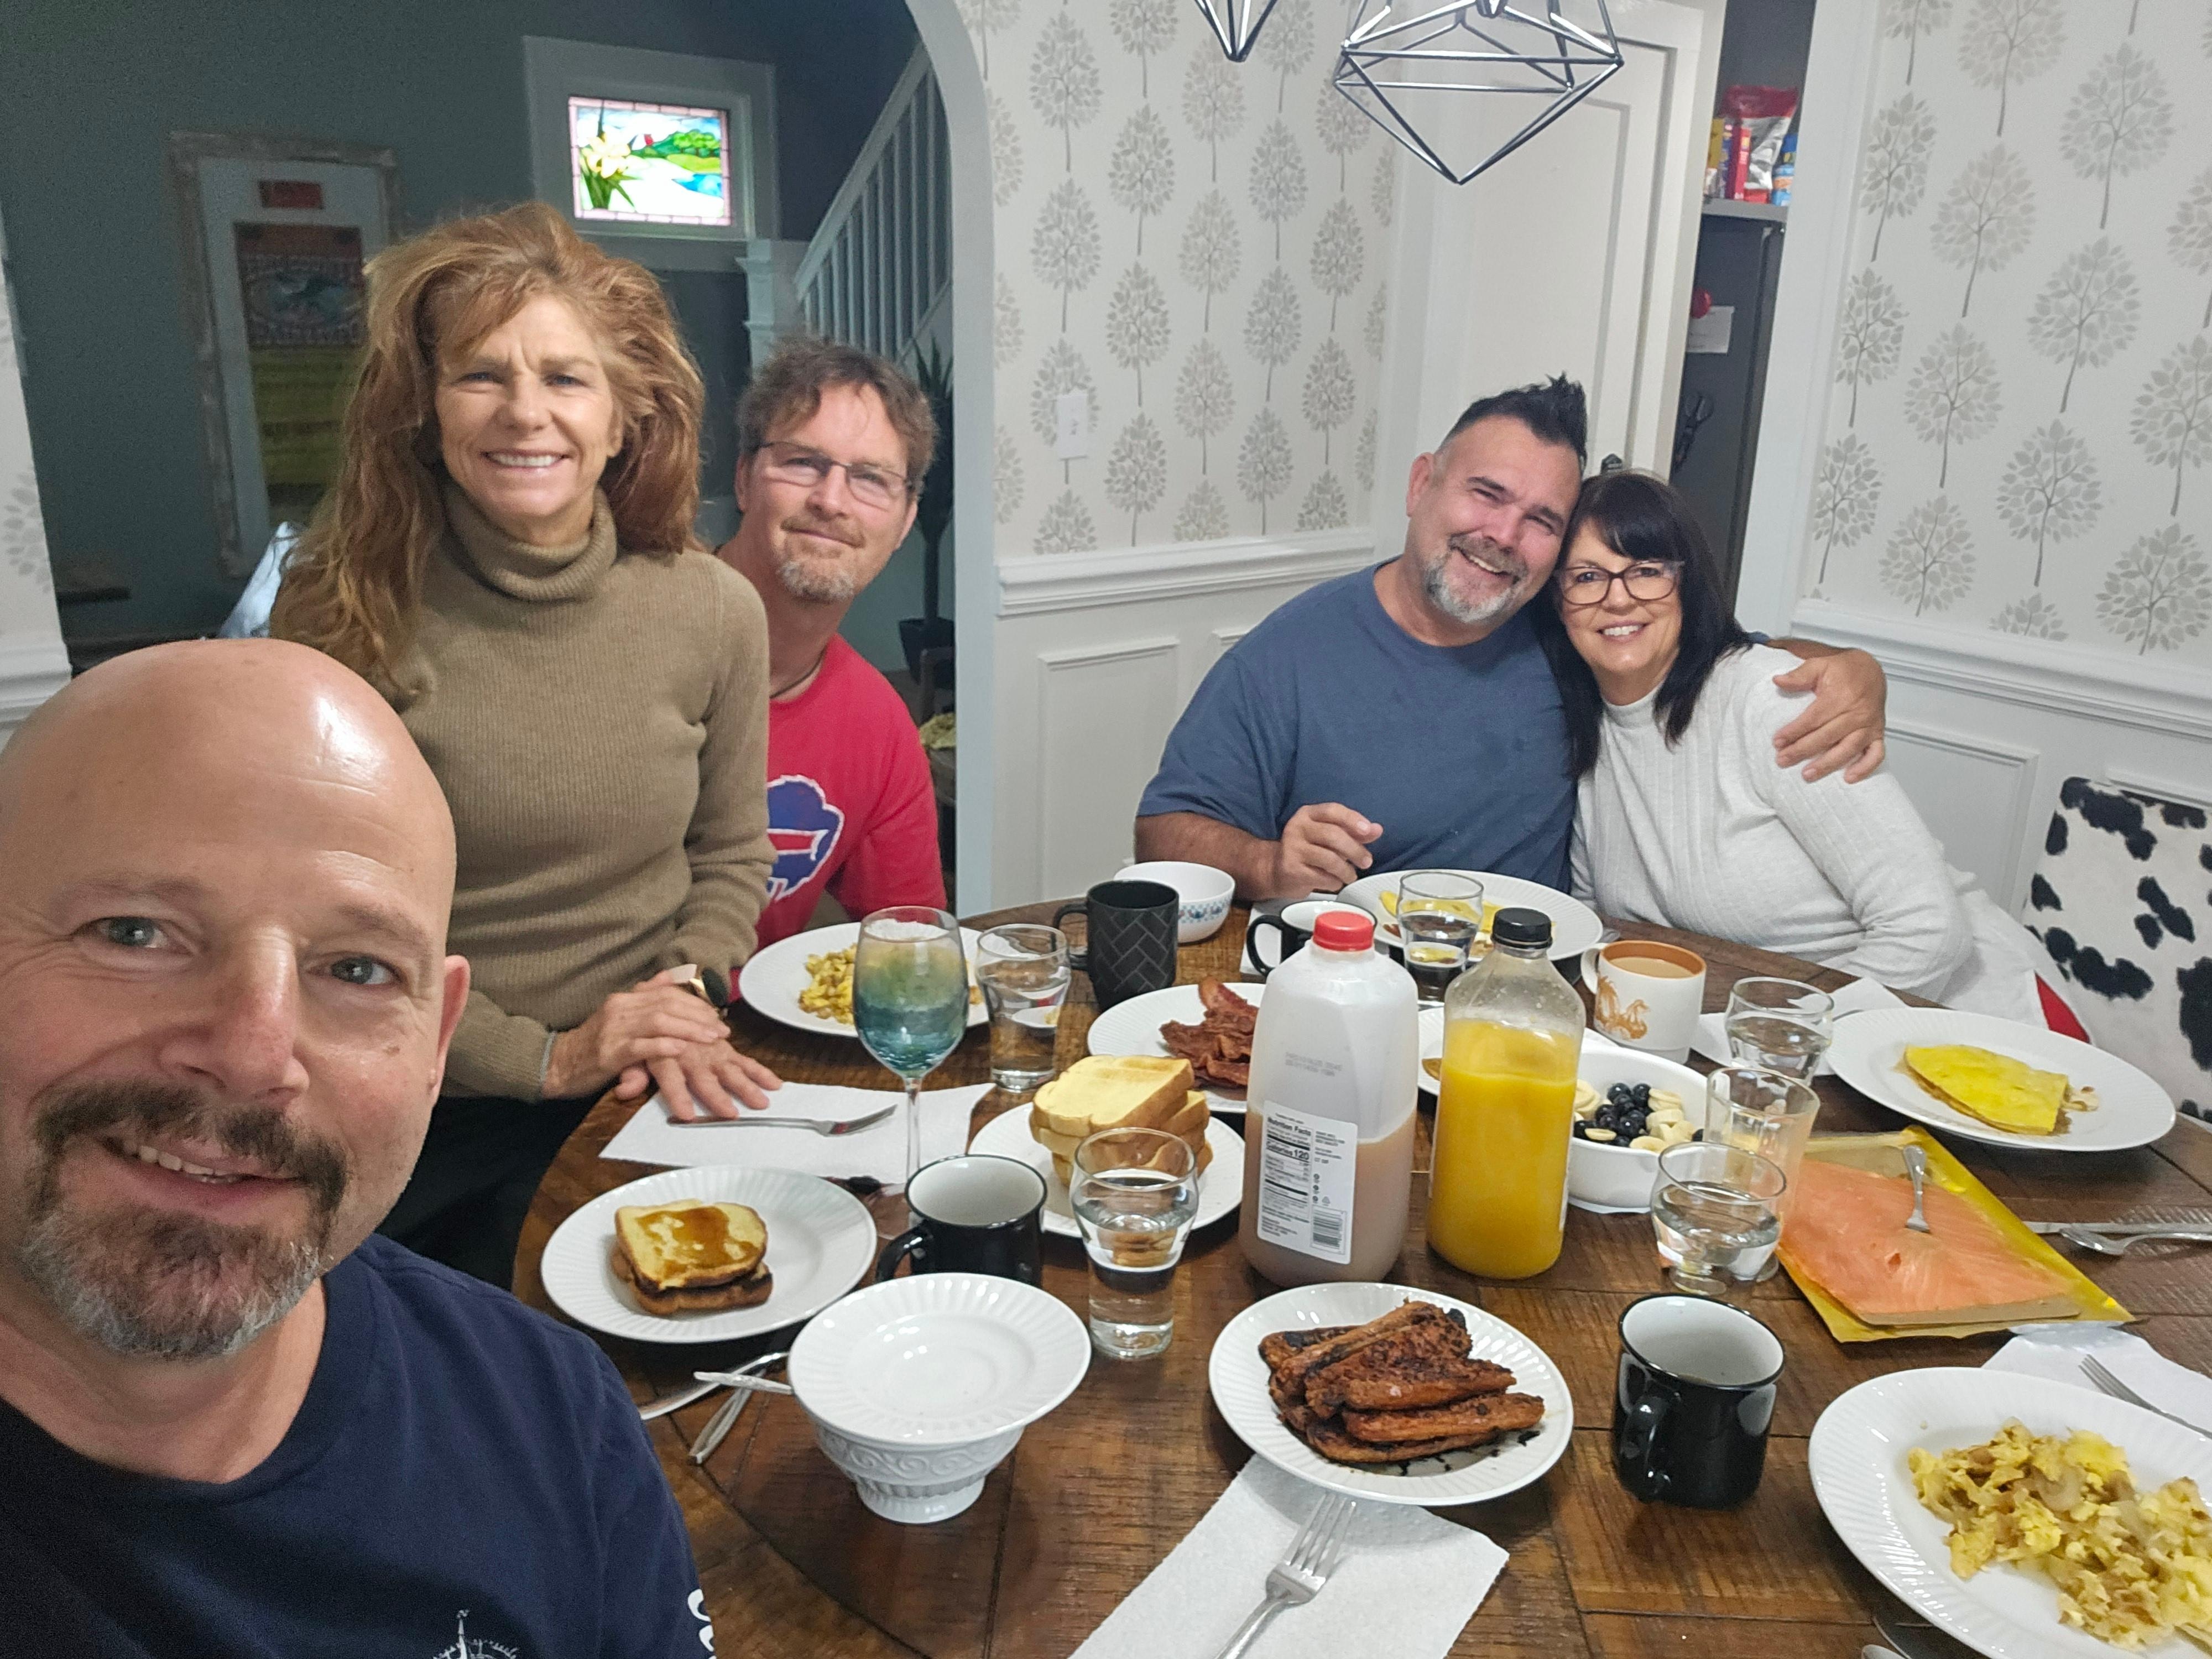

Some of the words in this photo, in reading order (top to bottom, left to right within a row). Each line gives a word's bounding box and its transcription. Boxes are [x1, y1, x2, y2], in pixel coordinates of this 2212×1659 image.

[1267, 1117, 1293, 1131] Nutrition
[1294, 1126, 1311, 1136] Facts
[1266, 1141, 1293, 1156] Calories
[1294, 1149, 1310, 1160] 120
